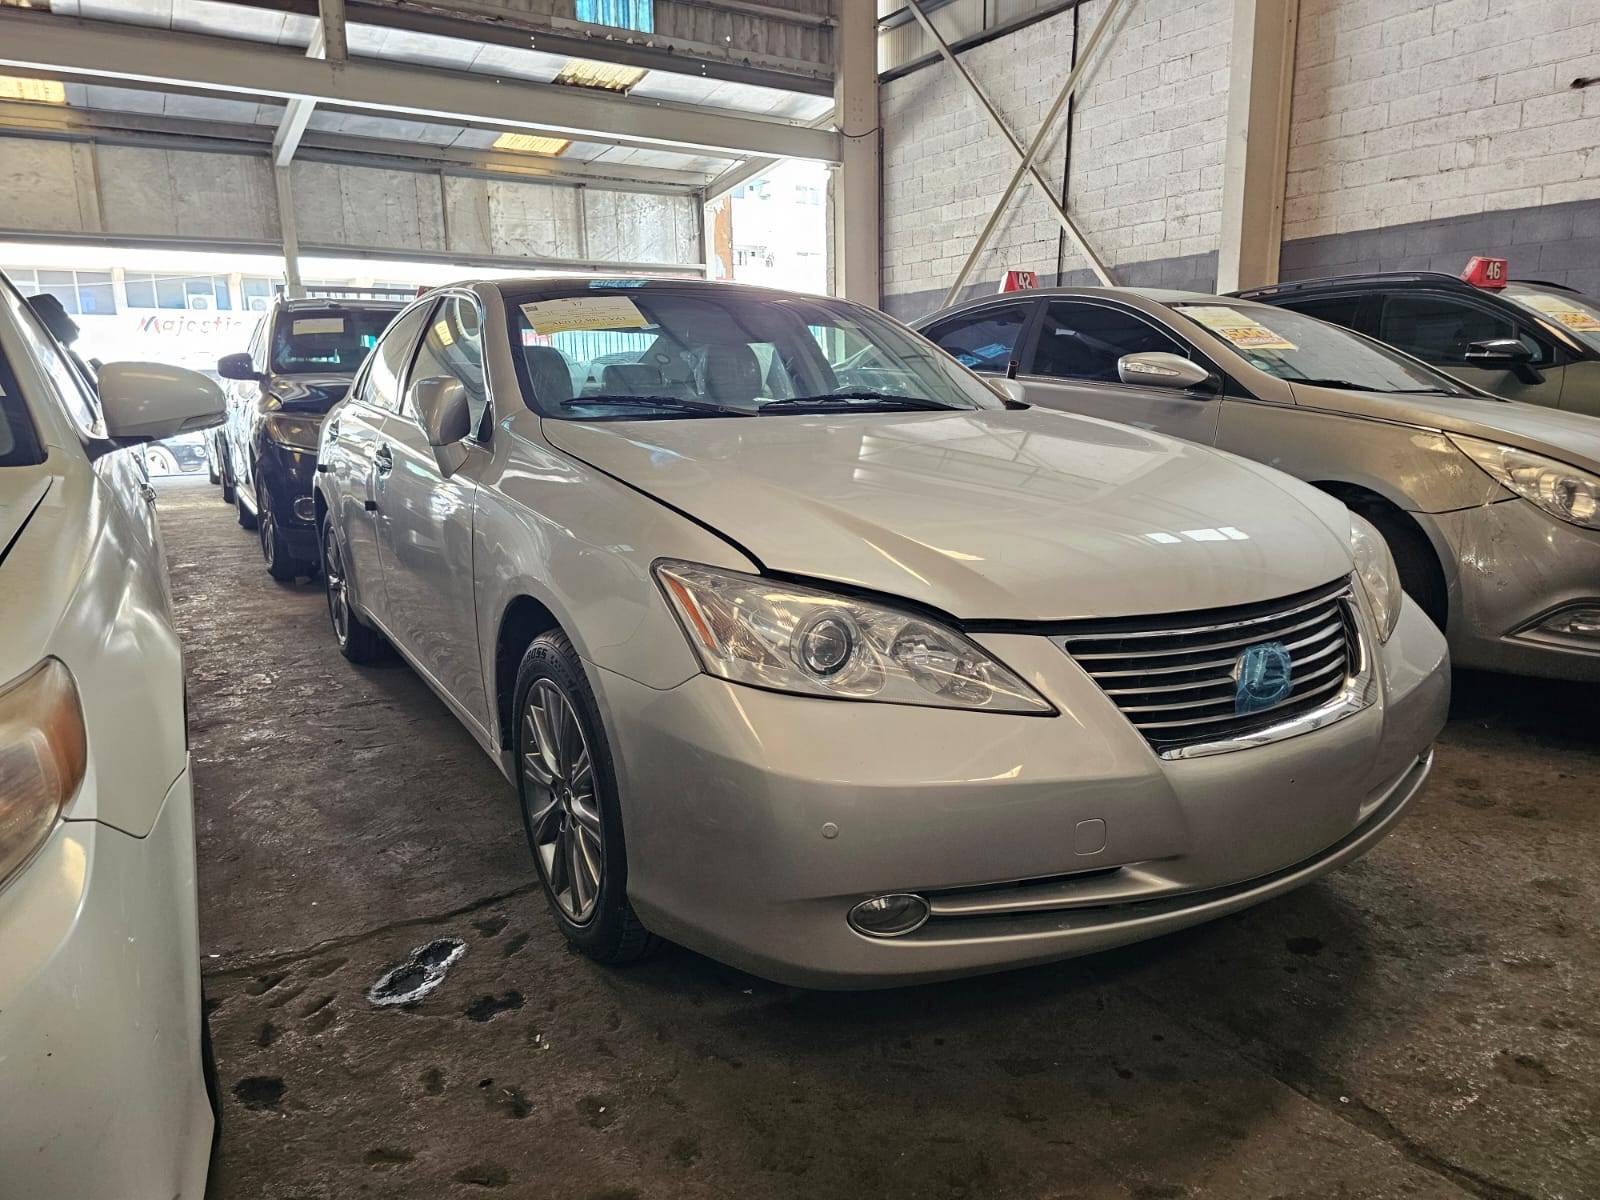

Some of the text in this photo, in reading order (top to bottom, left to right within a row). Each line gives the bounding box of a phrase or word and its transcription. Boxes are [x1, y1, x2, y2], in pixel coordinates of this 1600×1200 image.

[1486, 261, 1501, 279] 46
[1018, 272, 1032, 289] 42
[136, 315, 242, 336] Majestic
